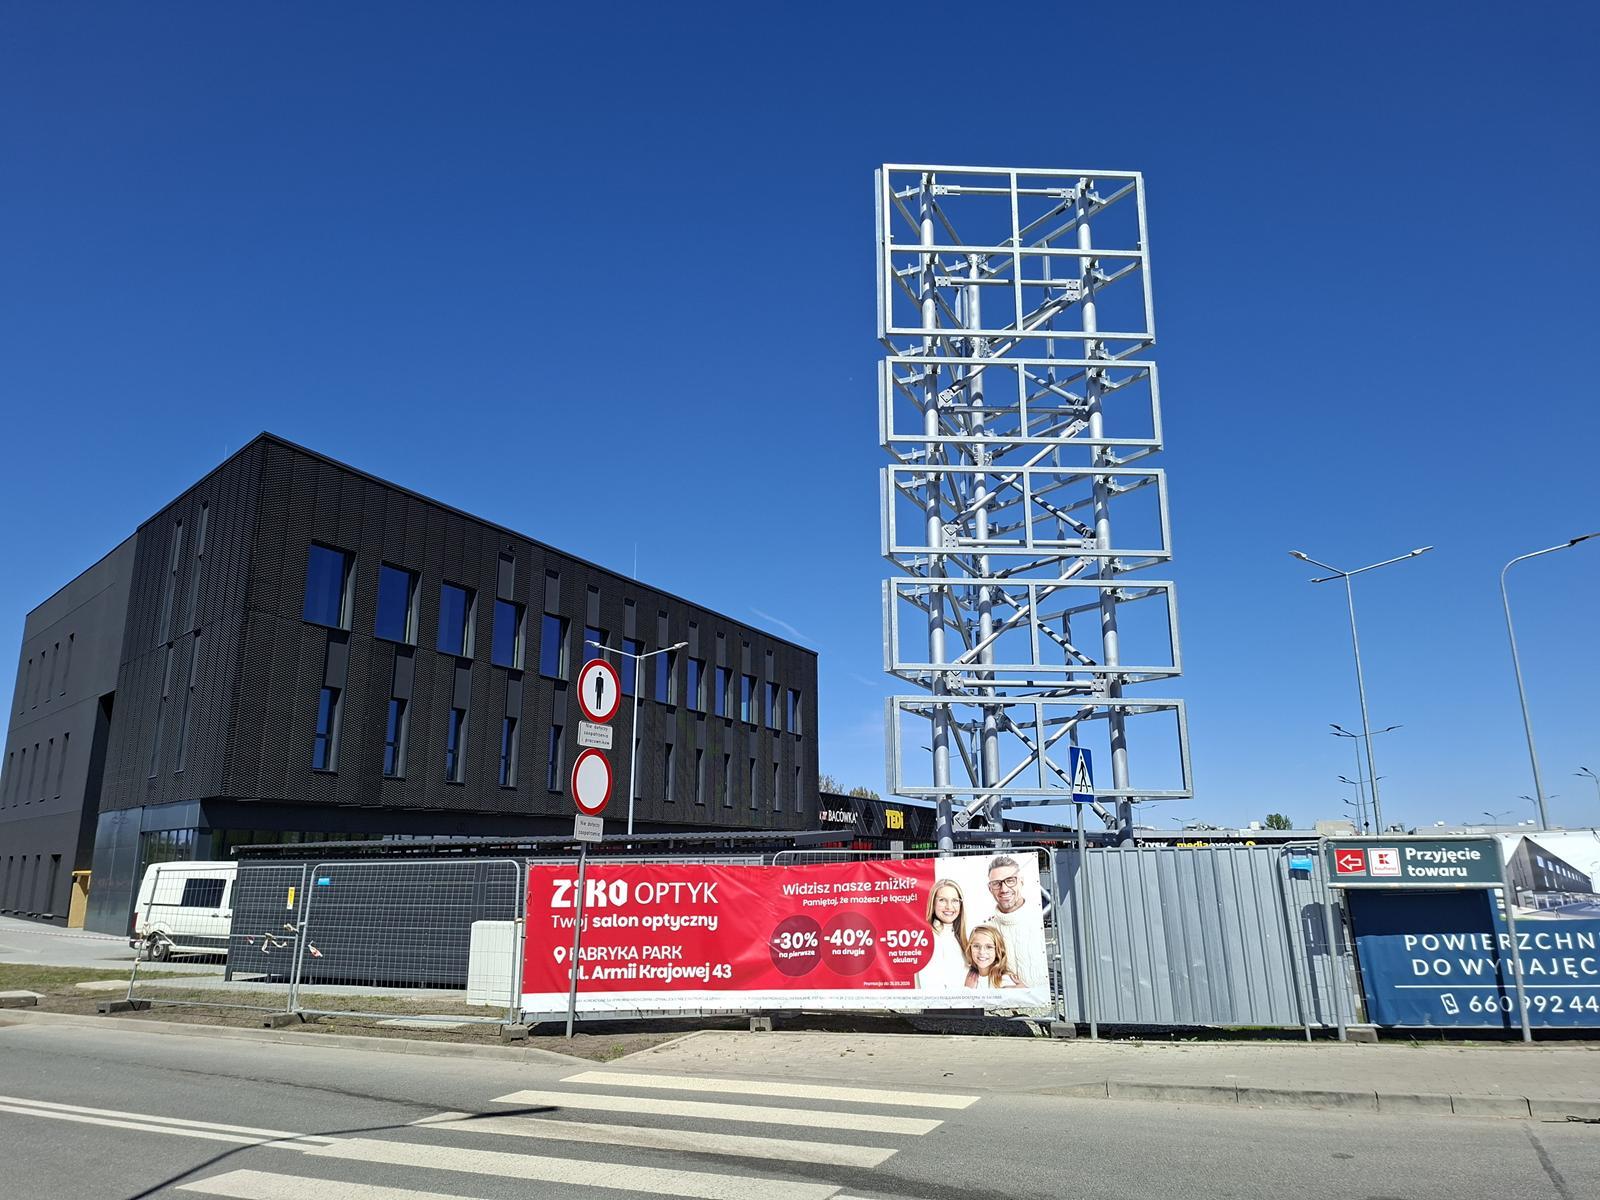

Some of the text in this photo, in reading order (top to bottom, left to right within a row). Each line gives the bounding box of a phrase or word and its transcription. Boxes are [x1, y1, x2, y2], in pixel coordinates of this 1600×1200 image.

[886, 809, 904, 829] TEDi
[1405, 848, 1481, 863] Przyjęcie
[1407, 865, 1468, 877] towaru
[634, 882, 718, 904] OPTYK
[783, 877, 918, 895] Widzisz nasze zniżki?
[802, 893, 918, 907] Pamiętaj, że możesz je łączyć!
[592, 914, 639, 927] salon
[642, 914, 718, 931] optyczny
[774, 932, 818, 950] -30%
[824, 928, 873, 947] -40%
[880, 930, 928, 947] -50%
[1404, 932, 1600, 951] POWIERZCHN
[642, 946, 682, 960] PARK
[842, 948, 865, 957] drugie
[893, 956, 918, 964] okulary
[591, 963, 637, 979] Armii
[639, 962, 710, 983] Krajowej
[712, 964, 732, 978] 43
[1412, 957, 1598, 978] DO WYNAJĘC
[1469, 995, 1513, 1012] 660
